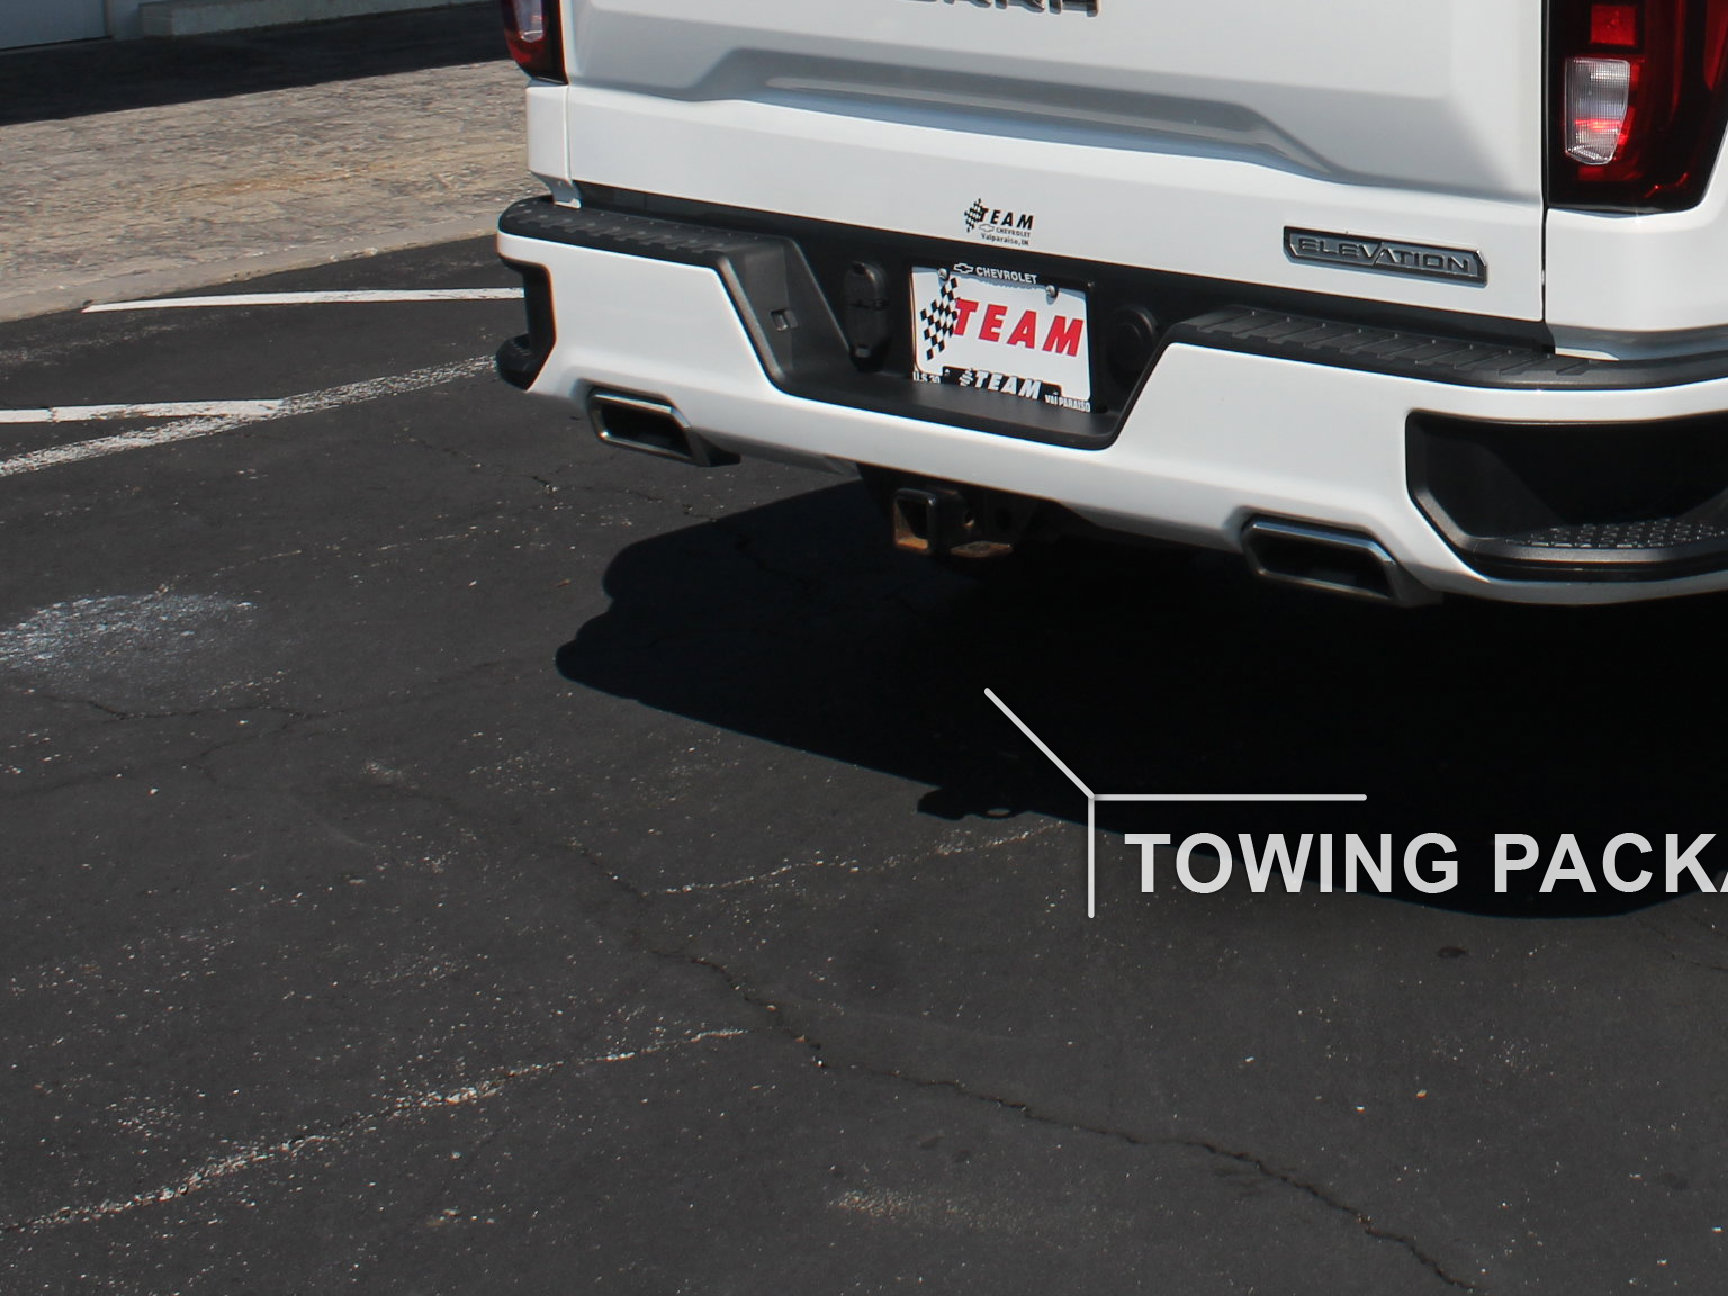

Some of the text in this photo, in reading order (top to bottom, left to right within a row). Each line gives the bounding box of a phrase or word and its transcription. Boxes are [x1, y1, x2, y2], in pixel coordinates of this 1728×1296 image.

[979, 206, 1034, 231] TEAM
[1298, 237, 1470, 272] ELEVATION
[976, 266, 1038, 285] CHEVROLET
[953, 297, 1084, 357] TEAM
[974, 370, 1043, 400] TEAM
